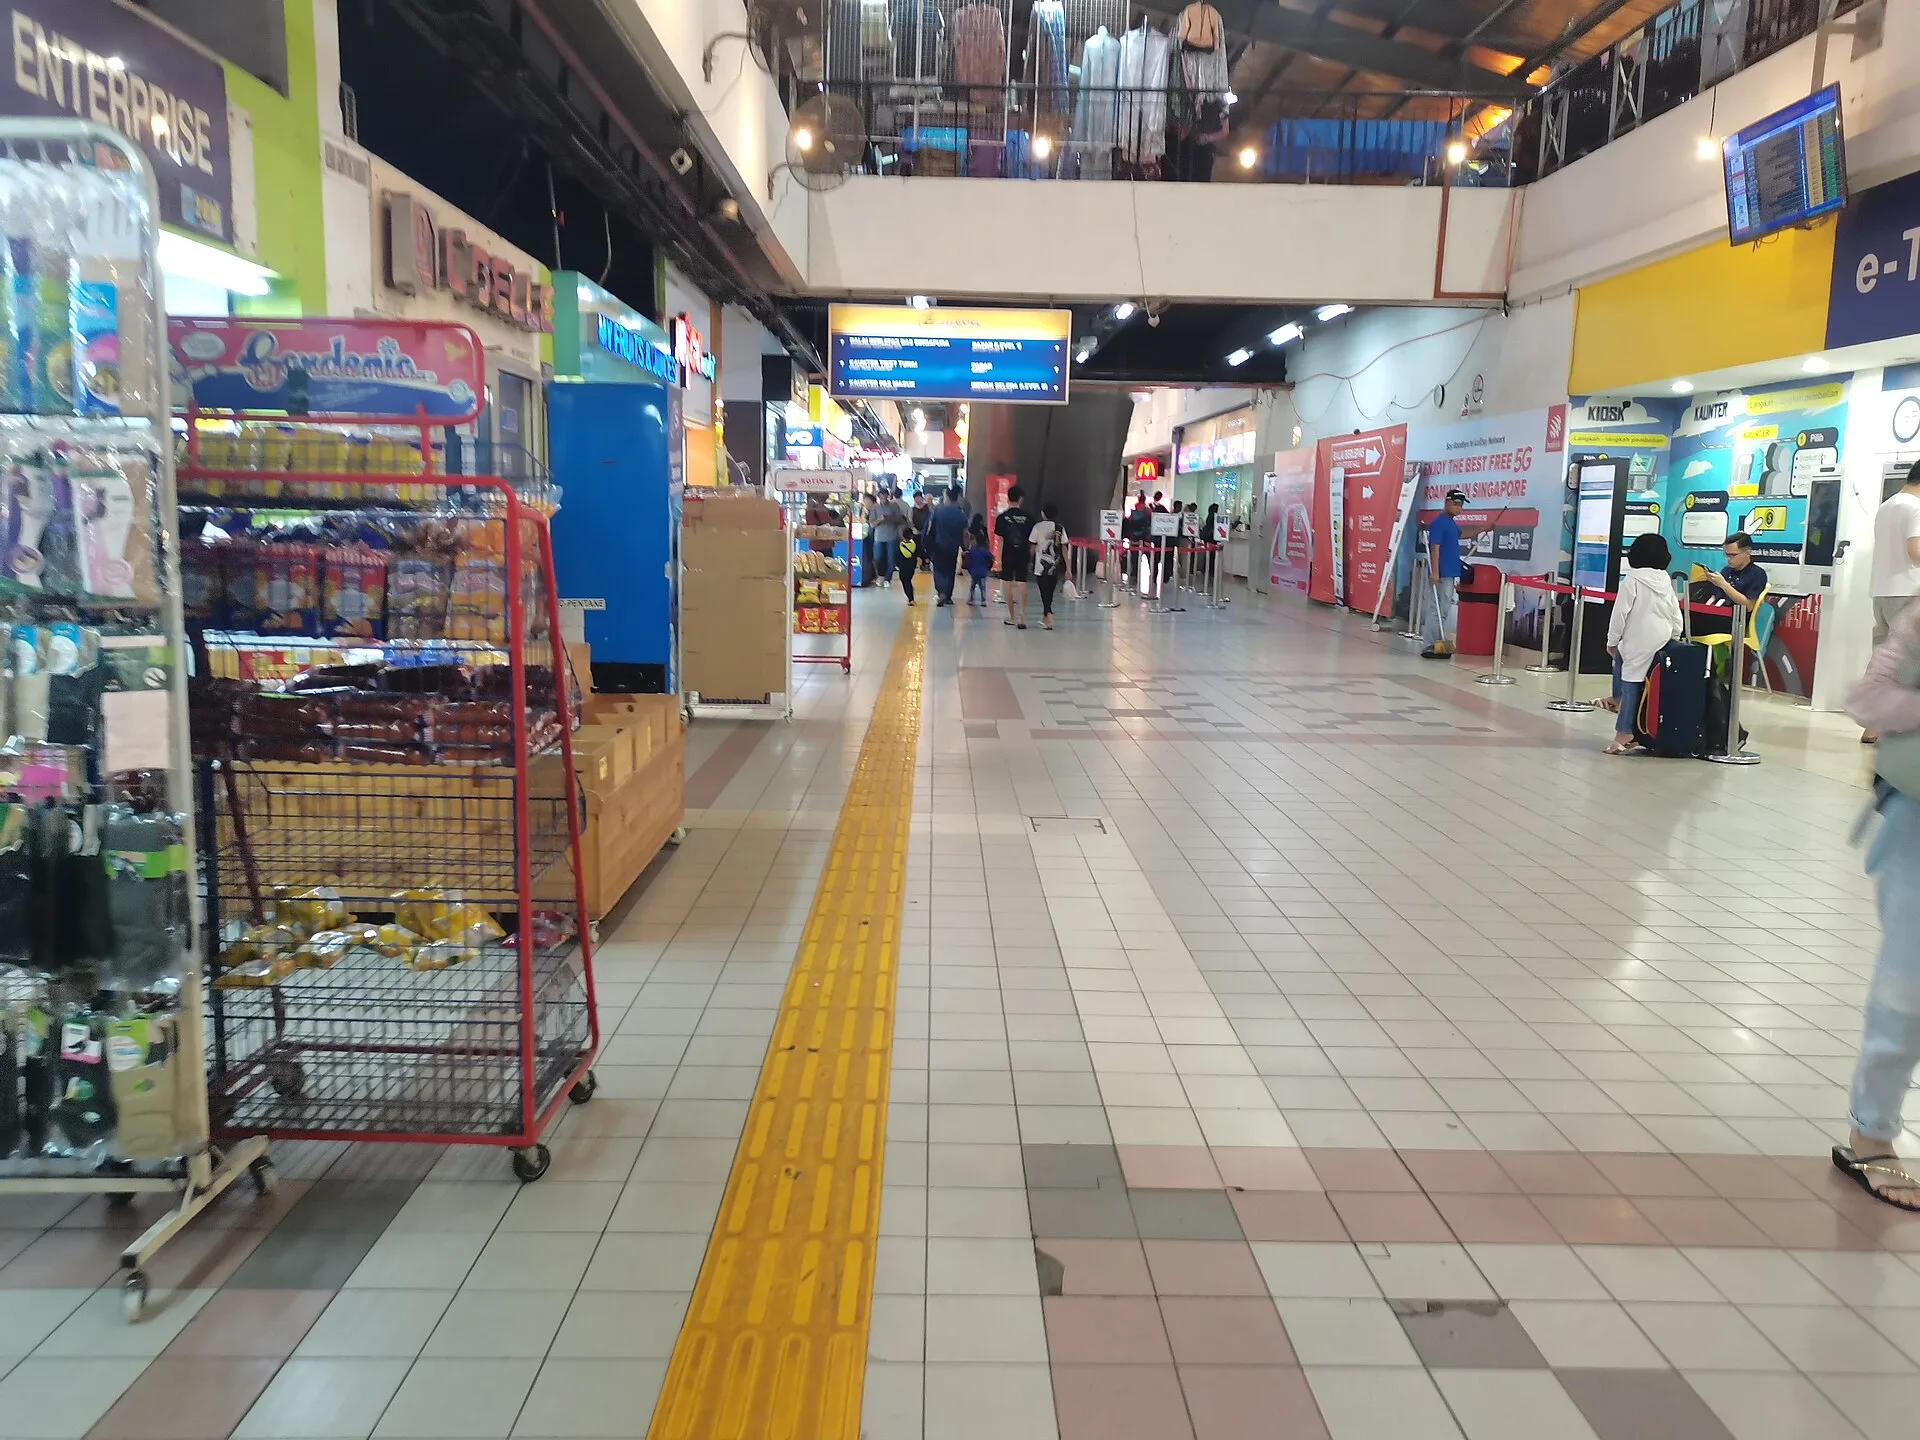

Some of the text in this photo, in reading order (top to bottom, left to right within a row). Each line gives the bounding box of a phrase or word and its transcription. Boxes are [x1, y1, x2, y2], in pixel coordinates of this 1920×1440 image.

[12, 8, 214, 177] ENTERPRISE
[1588, 406, 1625, 421] KIOSK
[1694, 402, 1728, 421] KAUNTER
[1810, 433, 1824, 443] Pilih
[1423, 446, 1532, 477] ENJOY THE BEST FREE 5G
[1472, 479, 1527, 499] SINGAPORE
